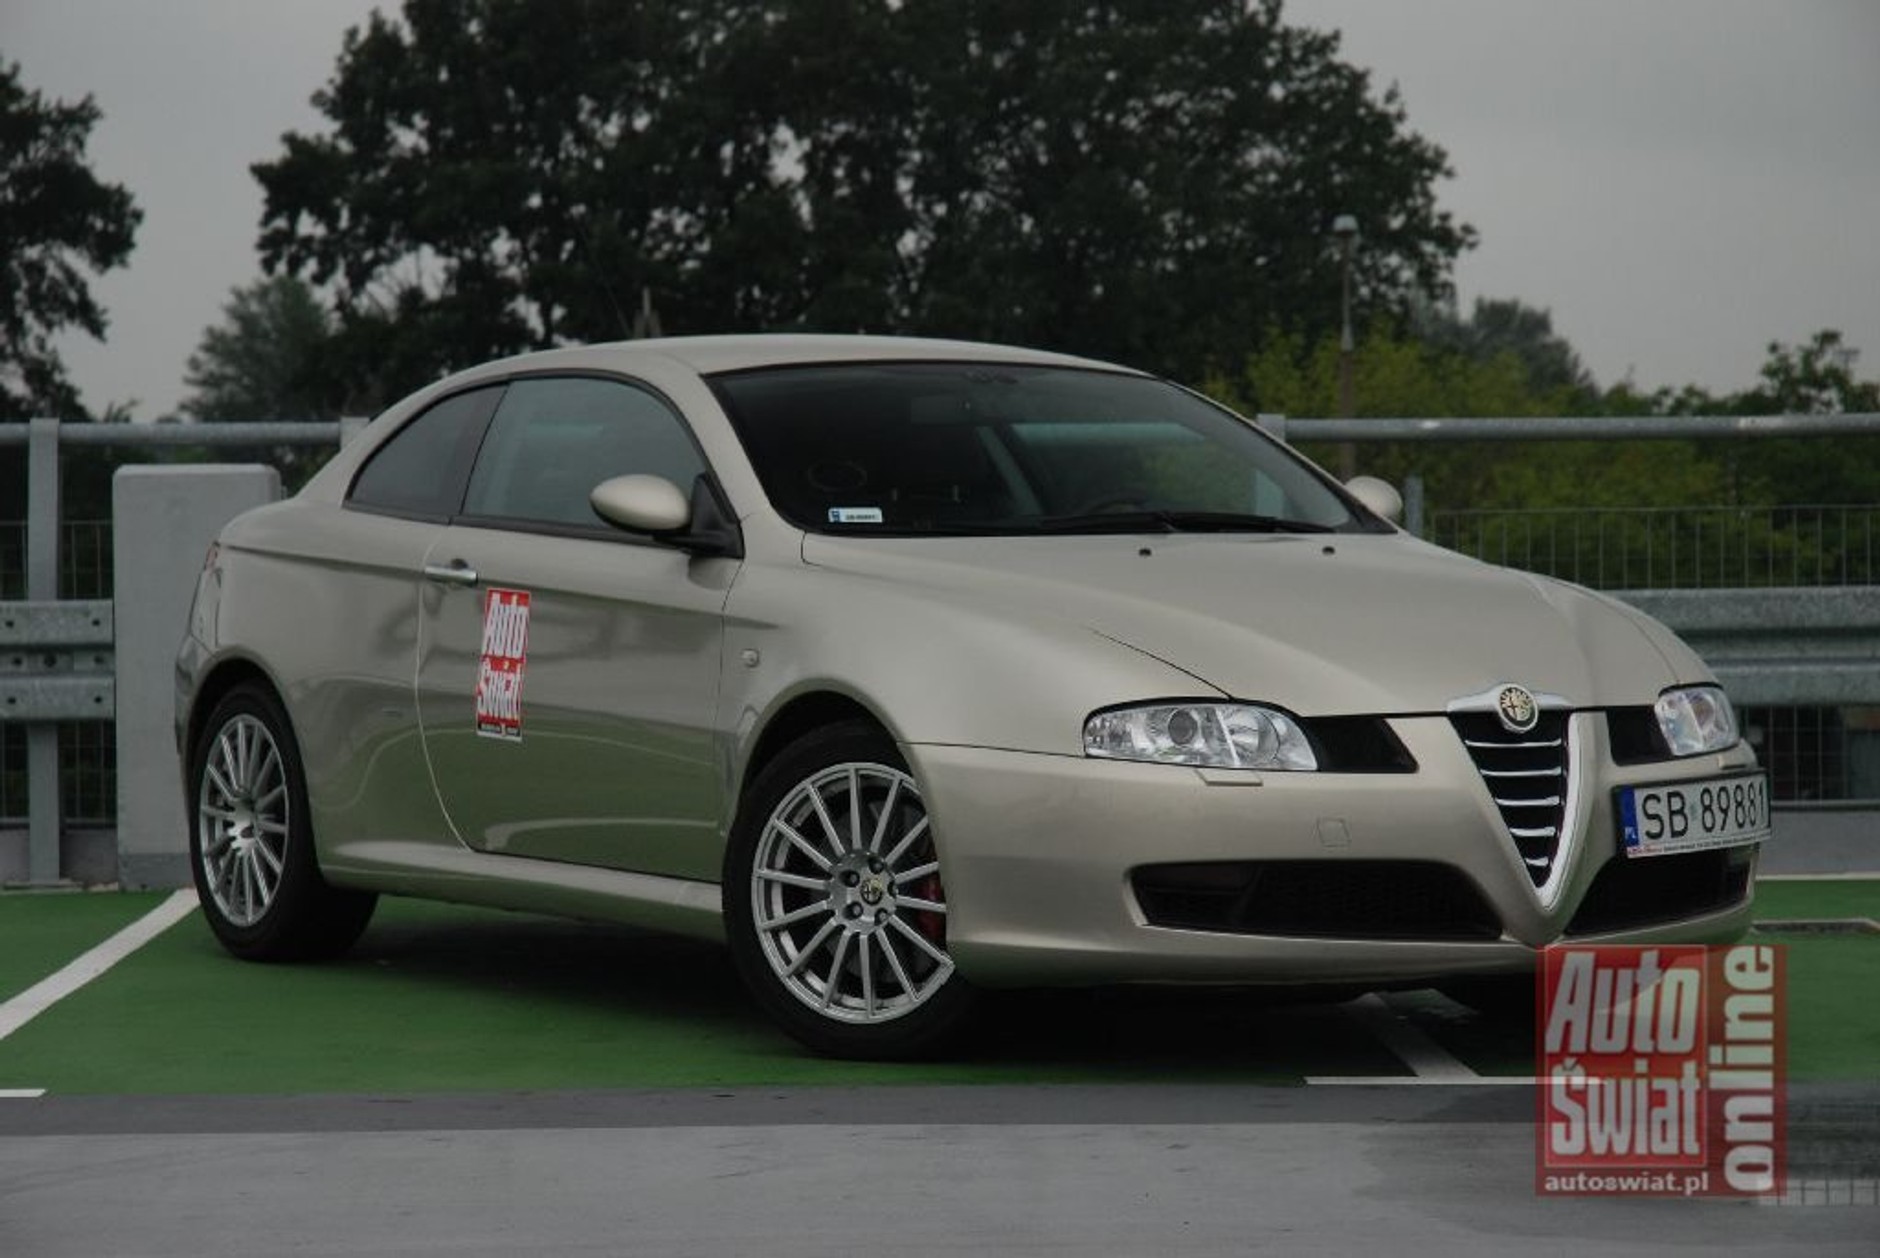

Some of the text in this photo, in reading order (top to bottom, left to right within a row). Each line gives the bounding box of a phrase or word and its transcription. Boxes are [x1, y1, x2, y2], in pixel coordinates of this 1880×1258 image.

[482, 591, 529, 658] Auto
[1641, 781, 1766, 840] SB 89881
